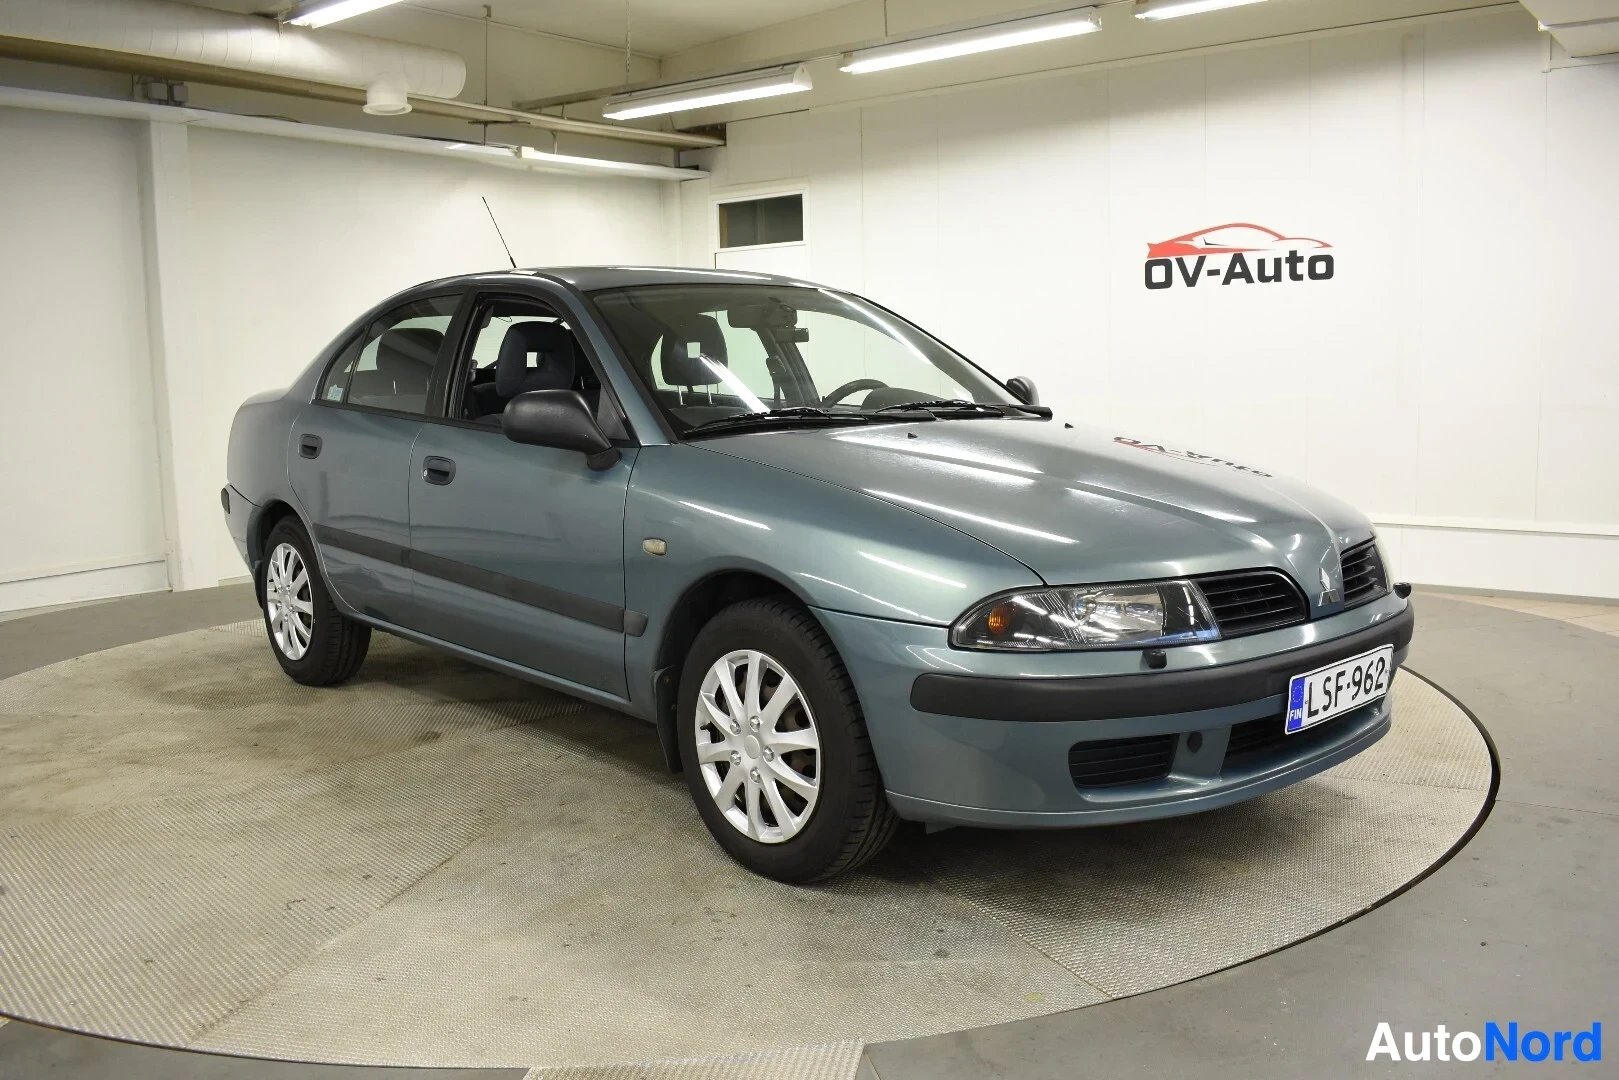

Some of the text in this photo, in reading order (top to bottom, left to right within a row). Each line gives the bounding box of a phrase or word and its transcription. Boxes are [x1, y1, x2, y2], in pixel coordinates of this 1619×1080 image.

[1145, 250, 1334, 290] OV-Auto
[1307, 656, 1386, 718] LSF-962
[1289, 707, 1303, 721] FIN
